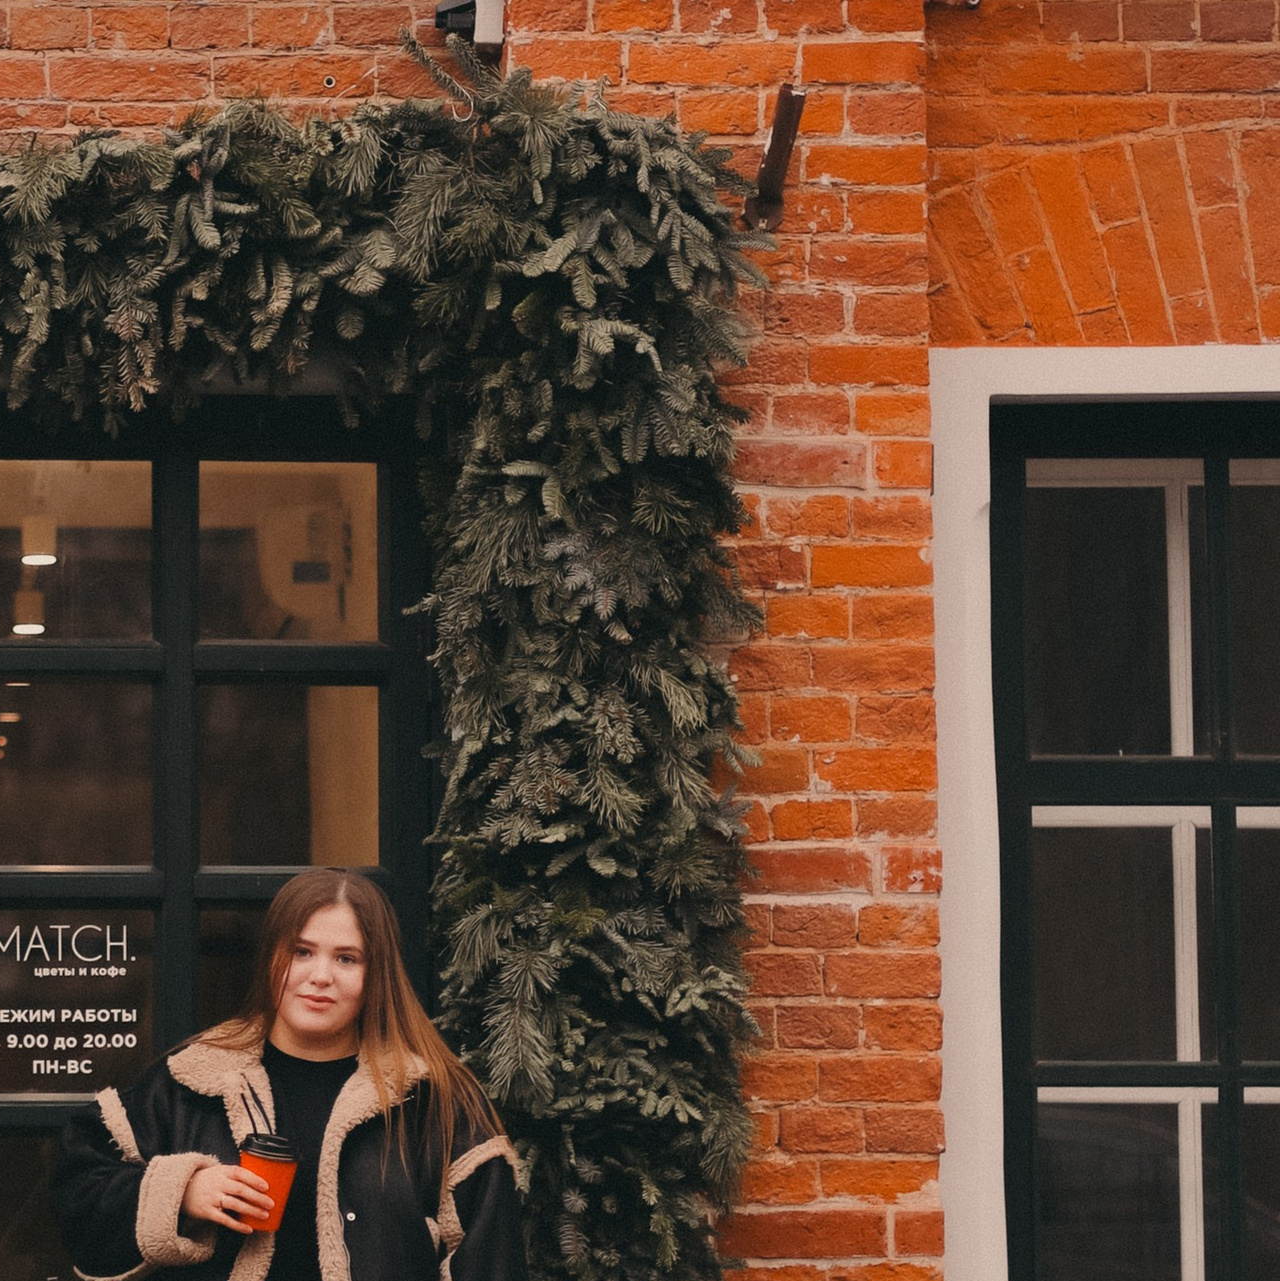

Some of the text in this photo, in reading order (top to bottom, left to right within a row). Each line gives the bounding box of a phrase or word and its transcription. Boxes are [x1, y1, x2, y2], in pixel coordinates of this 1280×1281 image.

[33, 965, 127, 978] цветы и кофе
[60, 1008, 137, 1023] РАБОТЫ
[6, 1033, 49, 1049] 9.00
[53, 1035, 78, 1051] до
[82, 1033, 138, 1049] 20.00
[32, 1059, 93, 1075] ПН-ВС
